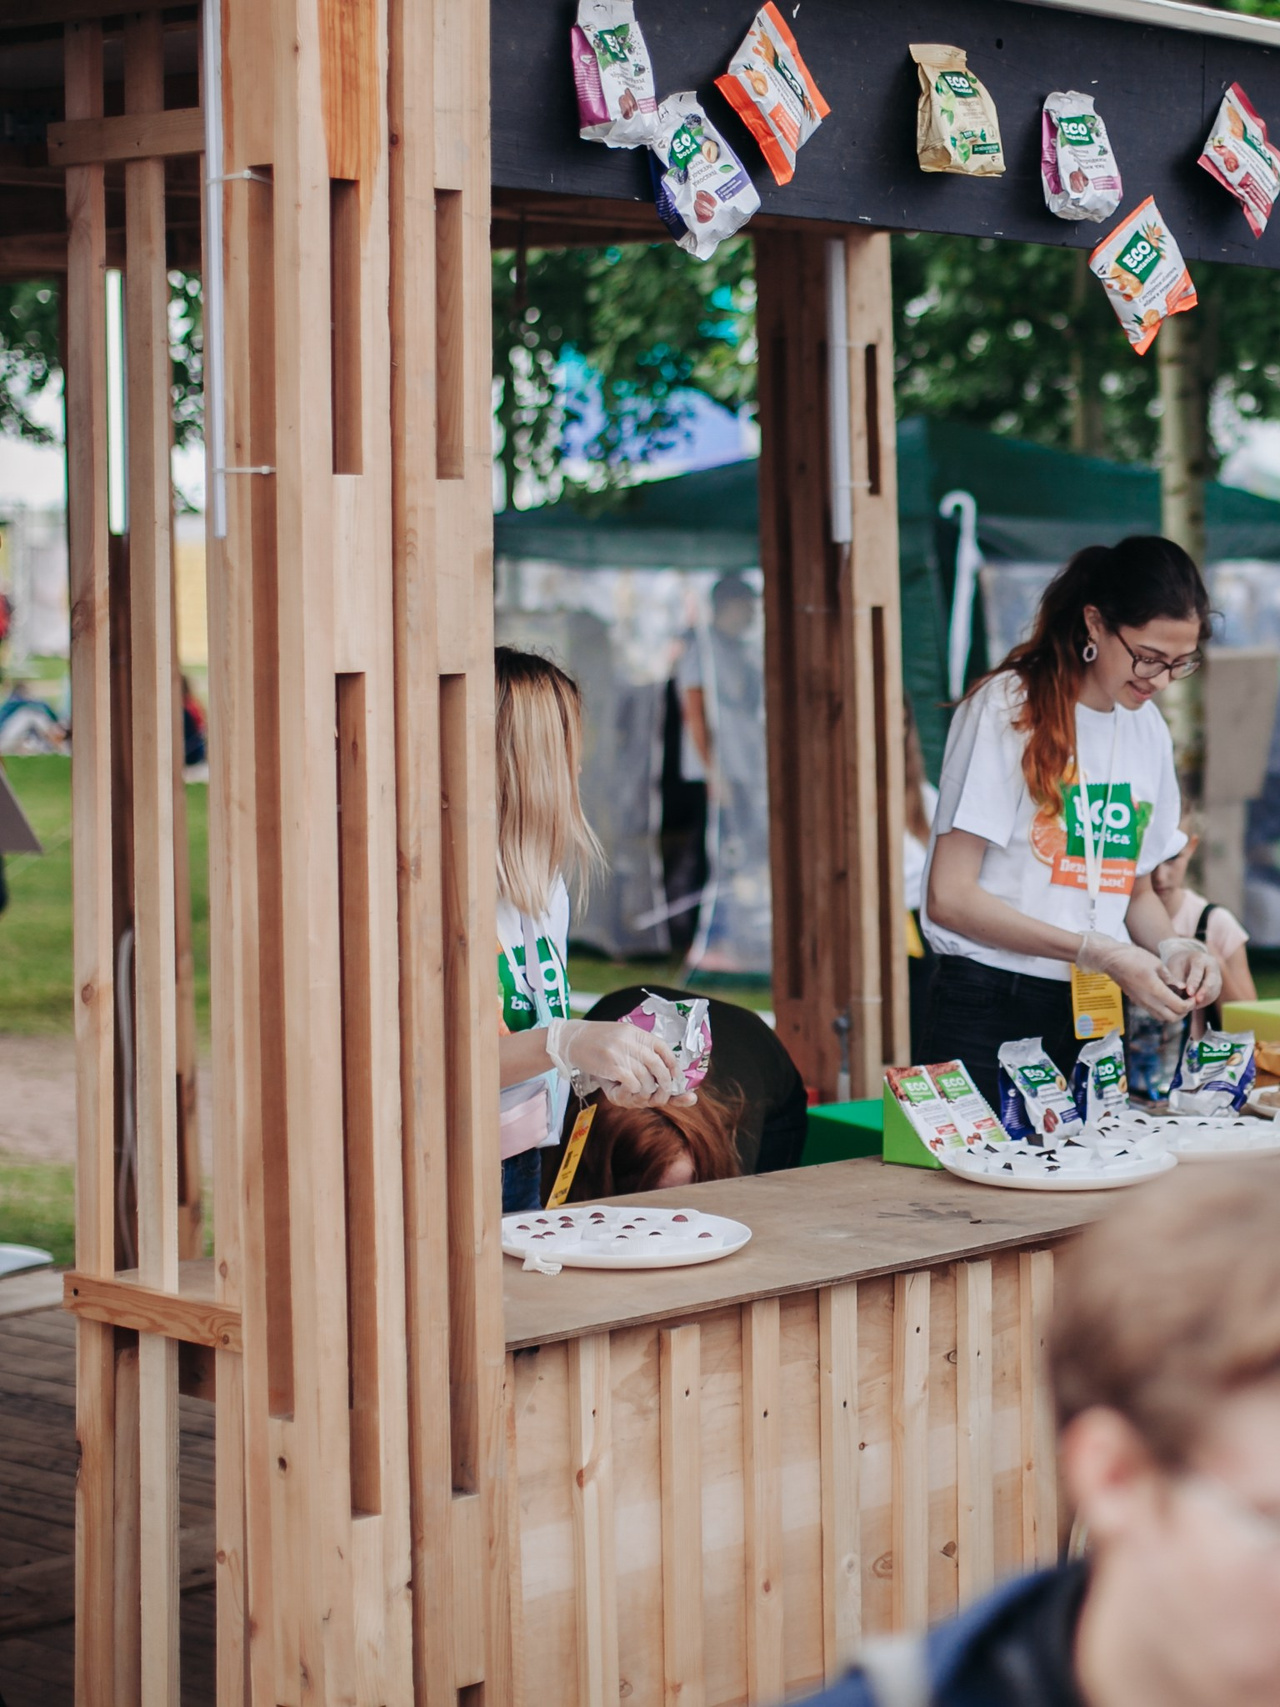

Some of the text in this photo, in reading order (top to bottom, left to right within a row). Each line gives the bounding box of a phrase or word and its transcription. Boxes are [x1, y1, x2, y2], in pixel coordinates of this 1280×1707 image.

[945, 76, 970, 88] ECO
[1061, 122, 1088, 135] ECO
[1122, 241, 1151, 268] ECO
[905, 1081, 928, 1091] ECO
[942, 1077, 965, 1088] ECO
